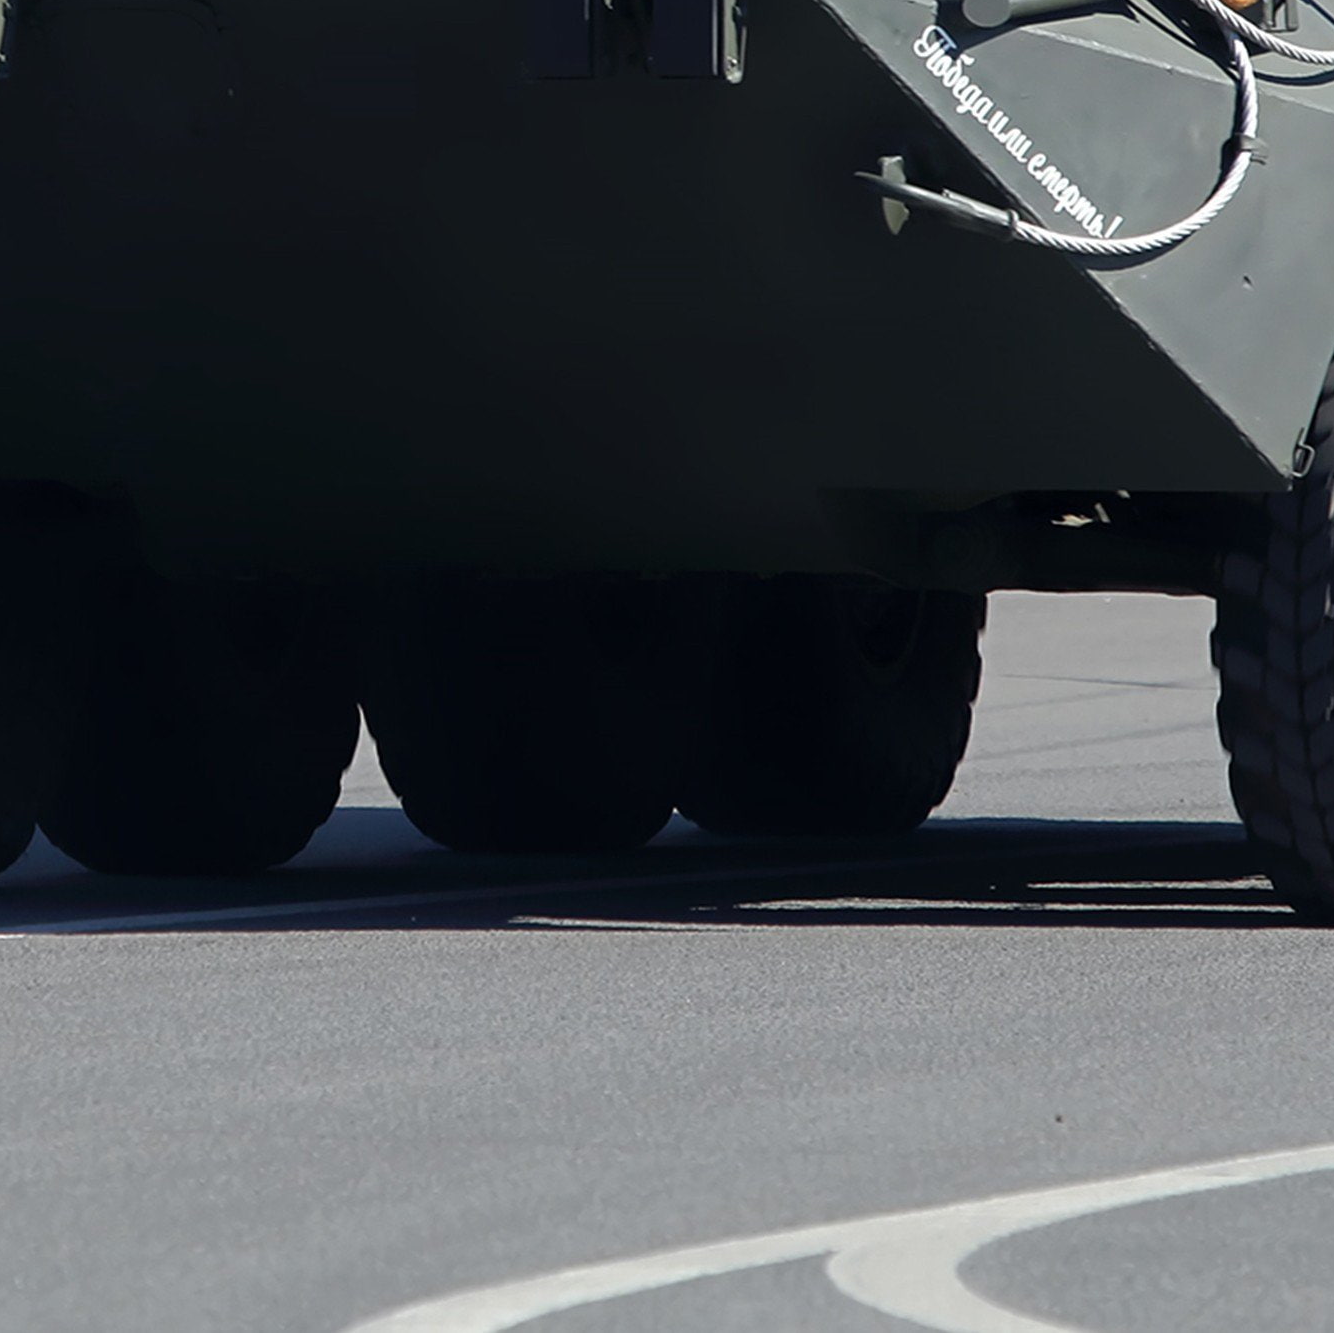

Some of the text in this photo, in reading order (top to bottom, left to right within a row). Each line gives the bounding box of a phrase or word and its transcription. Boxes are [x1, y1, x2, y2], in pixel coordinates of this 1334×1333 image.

[913, 24, 1124, 240] Победа или смерть!
